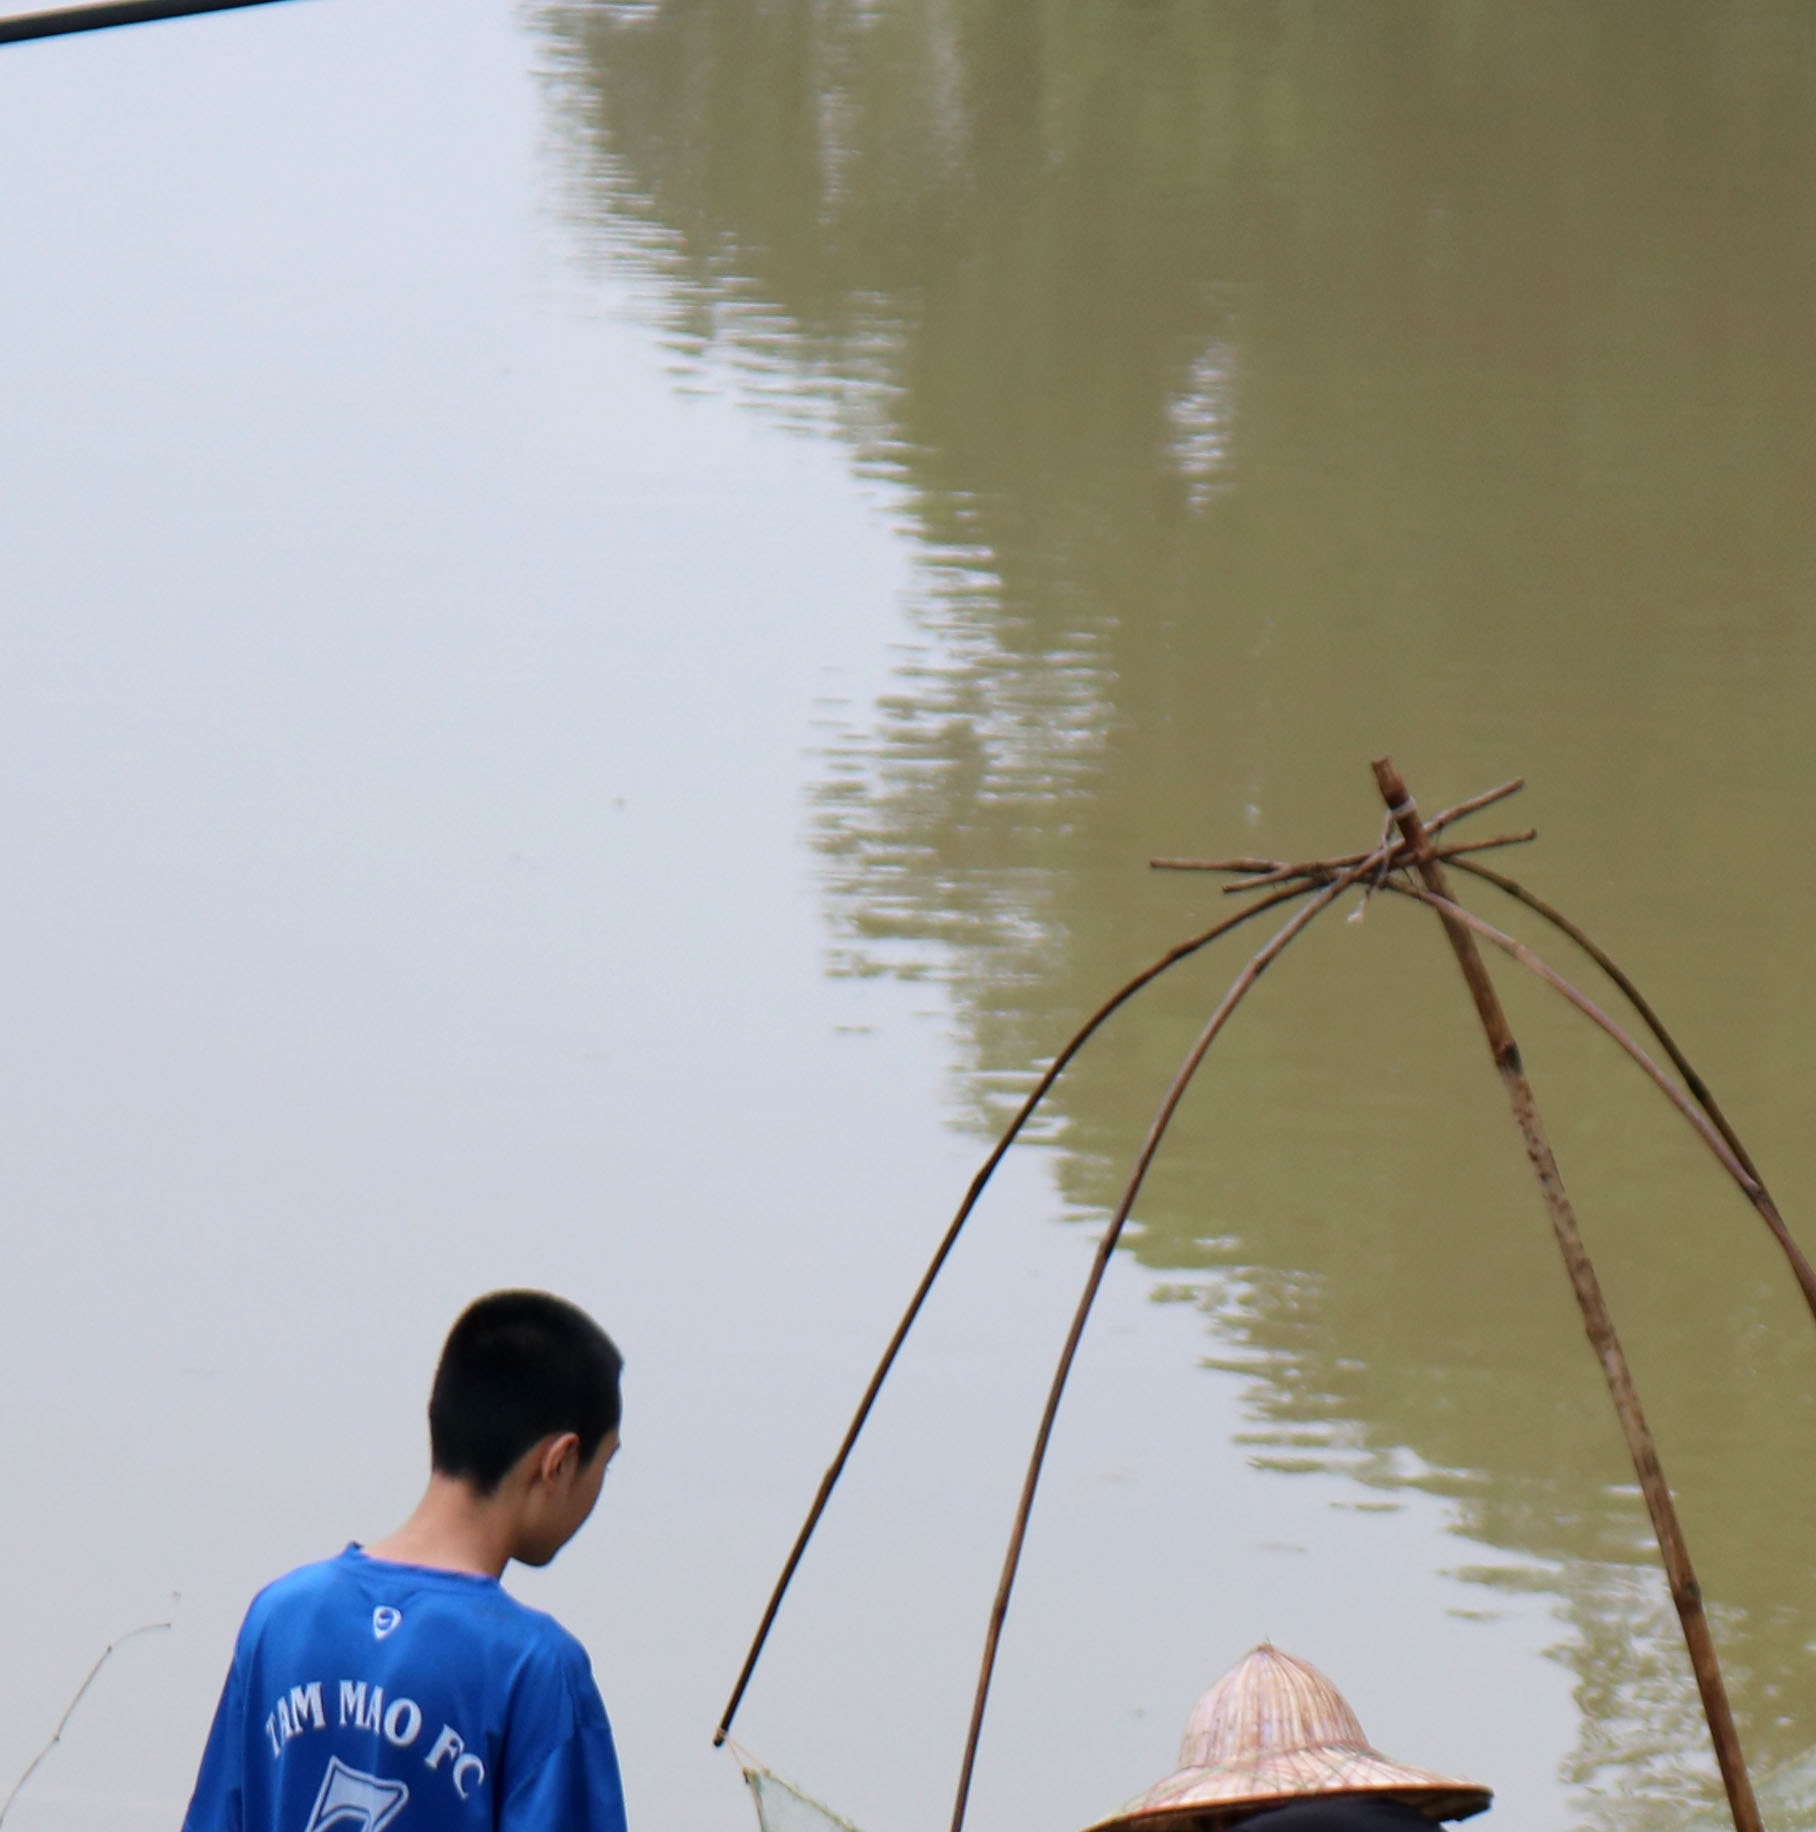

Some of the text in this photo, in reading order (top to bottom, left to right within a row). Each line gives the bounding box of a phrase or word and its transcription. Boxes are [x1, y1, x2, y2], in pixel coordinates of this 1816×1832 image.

[265, 1679, 484, 1799] TAM MAO FC
